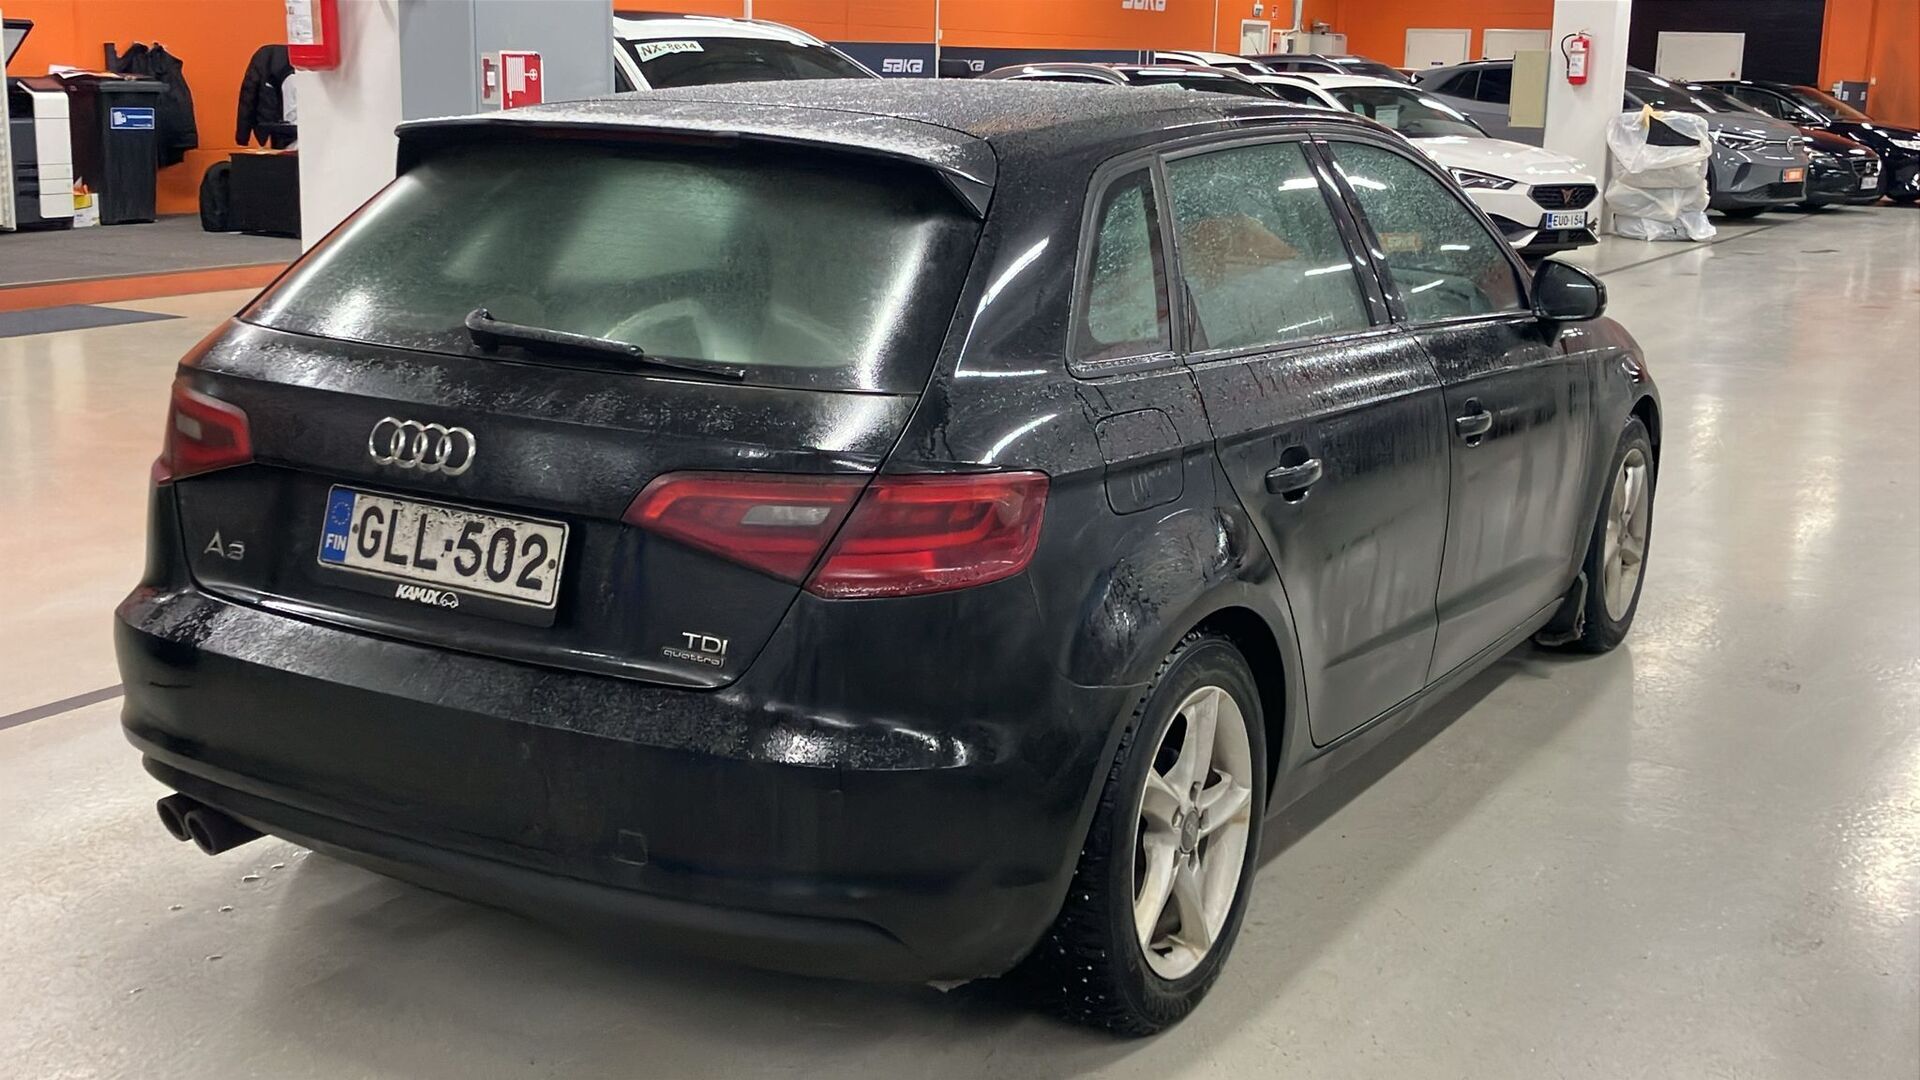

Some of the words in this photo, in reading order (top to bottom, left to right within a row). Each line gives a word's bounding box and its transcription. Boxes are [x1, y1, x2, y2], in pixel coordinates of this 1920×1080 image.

[203, 529, 246, 561] A3
[325, 533, 348, 552] FIN
[356, 505, 549, 591] GLL-502
[395, 583, 442, 606] KAMUX
[682, 631, 729, 656] TDI
[662, 648, 722, 667] quattro
